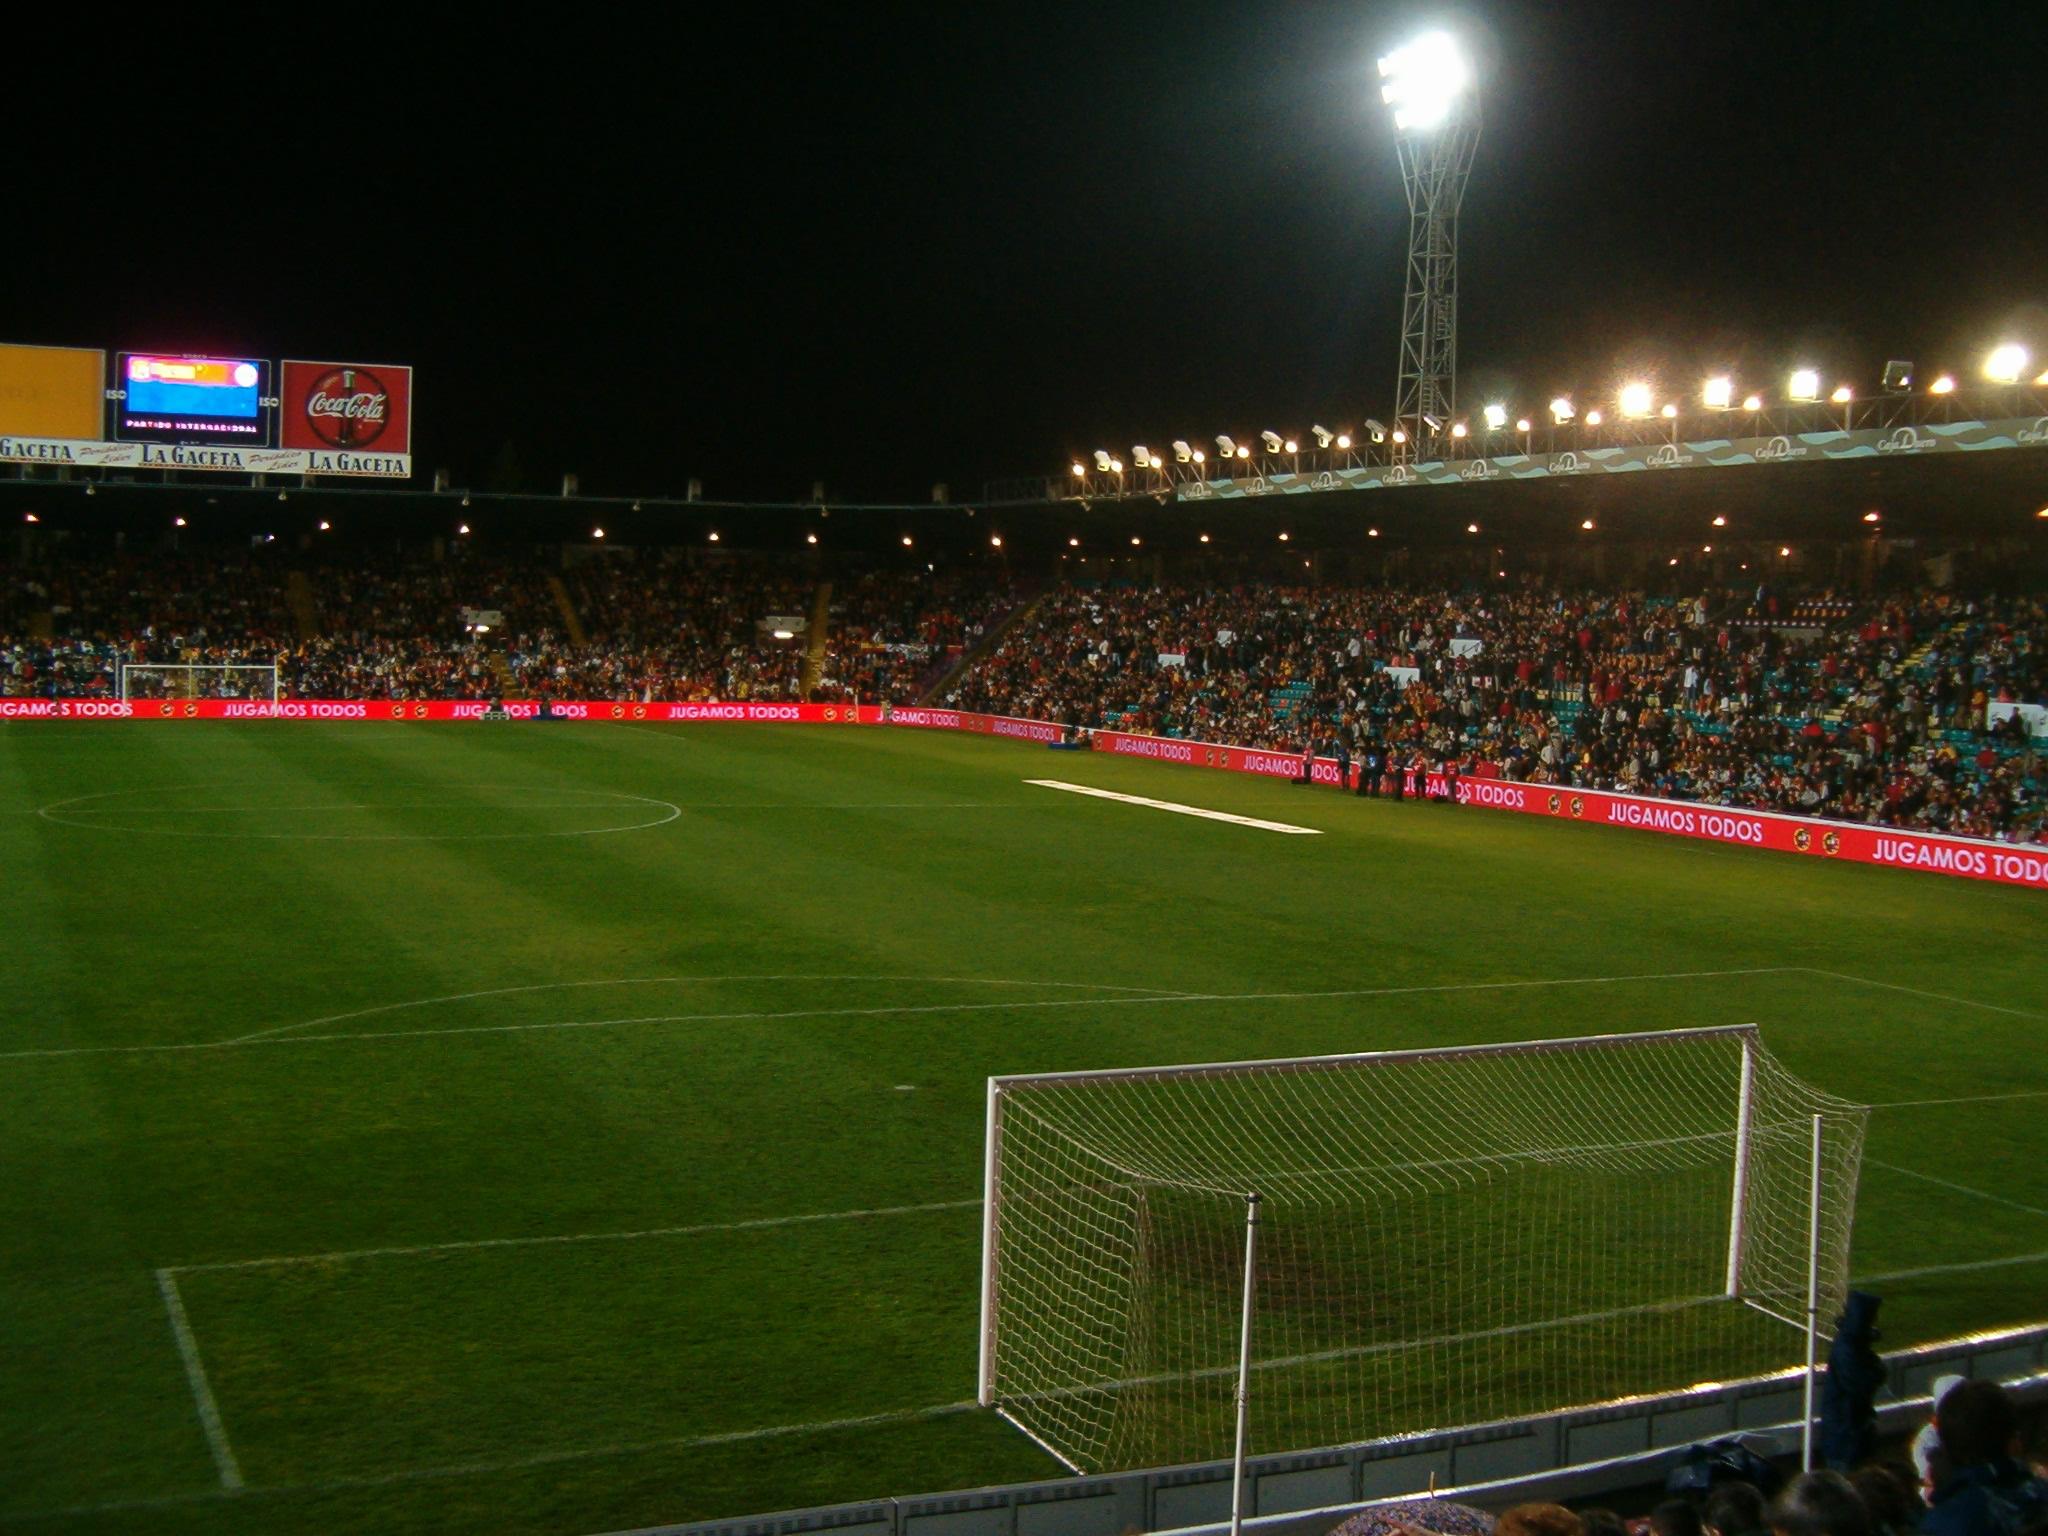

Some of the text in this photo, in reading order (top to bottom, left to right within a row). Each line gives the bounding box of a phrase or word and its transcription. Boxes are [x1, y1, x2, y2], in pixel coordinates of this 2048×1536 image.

[0, 438, 72, 459] GACETA
[172, 446, 242, 466] GACETA
[337, 453, 405, 473] GACETA
[0, 703, 133, 716] GAMOS TODOS
[223, 703, 366, 717] JUGAMOS TODOS
[532, 704, 587, 717] TDOS
[669, 706, 799, 719] JUGAMOS TODOS
[876, 711, 960, 728] JGAMOS TODOS
[992, 720, 1055, 741] JUGAMOS TODOS
[1115, 738, 1192, 761] JUGAMOS TODOS
[1243, 755, 1339, 783] JUGAMOS TDOS
[1475, 784, 1525, 808] TODOS
[1607, 802, 1763, 842] JUGAMOS TODOS
[1872, 838, 1987, 875] JUGAMOS
